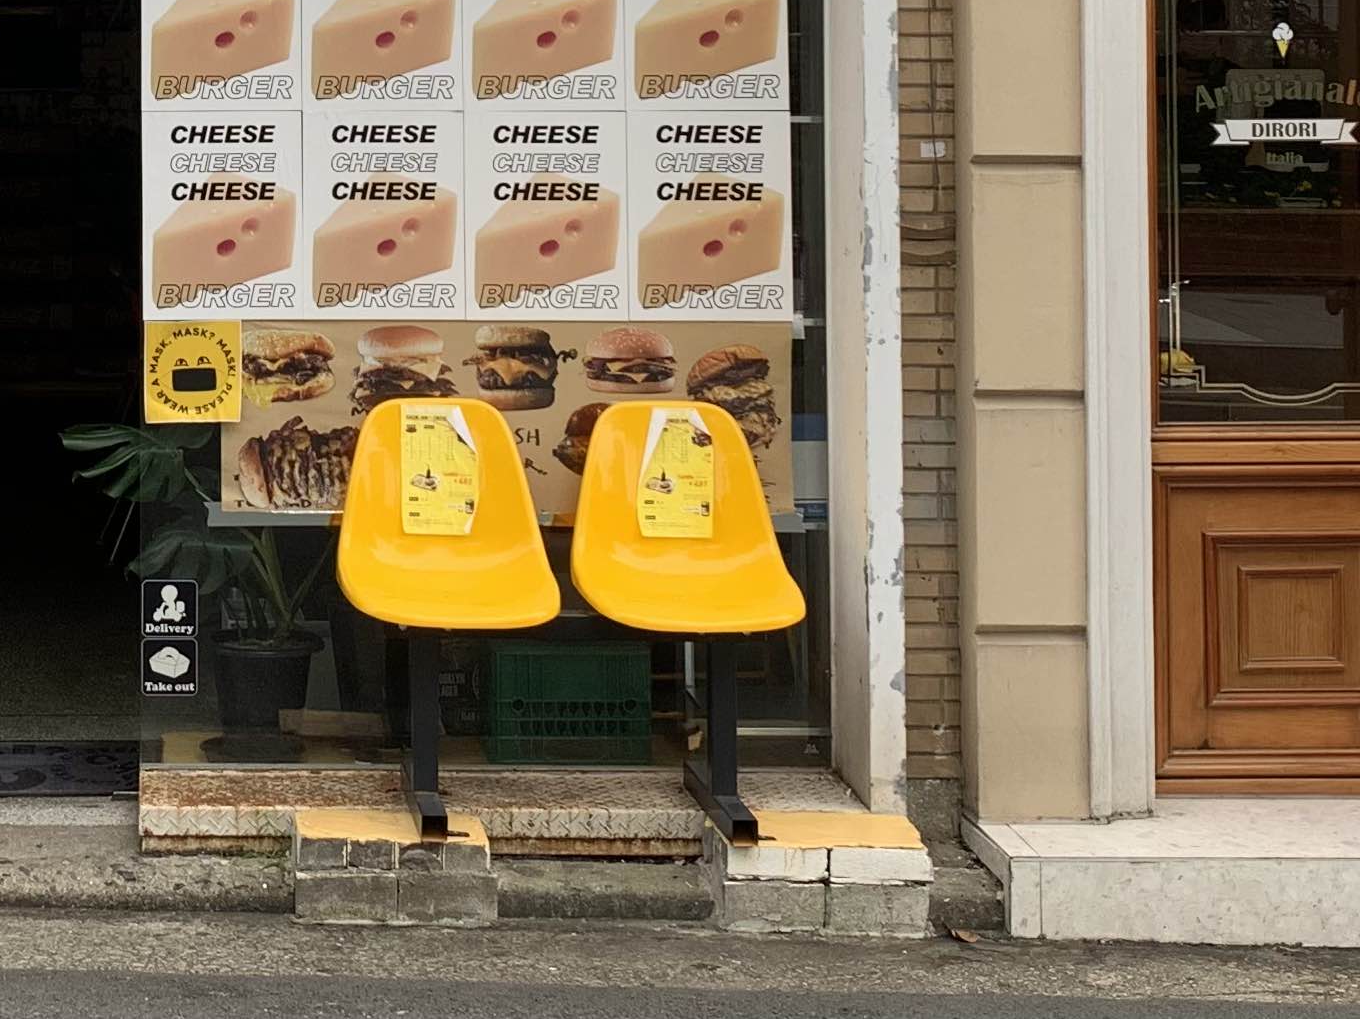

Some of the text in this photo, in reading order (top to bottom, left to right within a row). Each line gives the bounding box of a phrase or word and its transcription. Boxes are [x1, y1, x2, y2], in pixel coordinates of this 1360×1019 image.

[155, 75, 293, 100] BURGER
[315, 75, 454, 100] BURGER
[477, 75, 616, 100] BURGER
[639, 74, 780, 99] BURGER
[1196, 73, 1360, 113] Artigianal
[170, 125, 275, 143] CHEESE
[332, 125, 437, 143] CHEESE
[493, 125, 599, 144] CHEESE
[656, 125, 763, 143] CHEESE
[1252, 122, 1317, 137] DIRORI
[170, 152, 276, 173] CHEESE
[331, 152, 438, 173] CHEESE
[492, 153, 600, 173] CHEESE
[655, 153, 764, 173] CHEESE
[171, 182, 276, 201] CHEESE
[332, 182, 437, 201] CHEESE
[493, 182, 599, 201] CHEESE
[656, 182, 763, 201] CHEESE
[157, 283, 296, 309] BURGER
[317, 283, 457, 309] BURGER
[479, 284, 619, 309] BURGER
[642, 284, 784, 309] BURGER
[173, 327, 216, 341] MASK?
[151, 378, 160, 387] A
[156, 390, 189, 415] WEAR
[195, 382, 233, 414] PLEASE
[145, 623, 194, 635] Delivery
[144, 682, 195, 692] Take out
